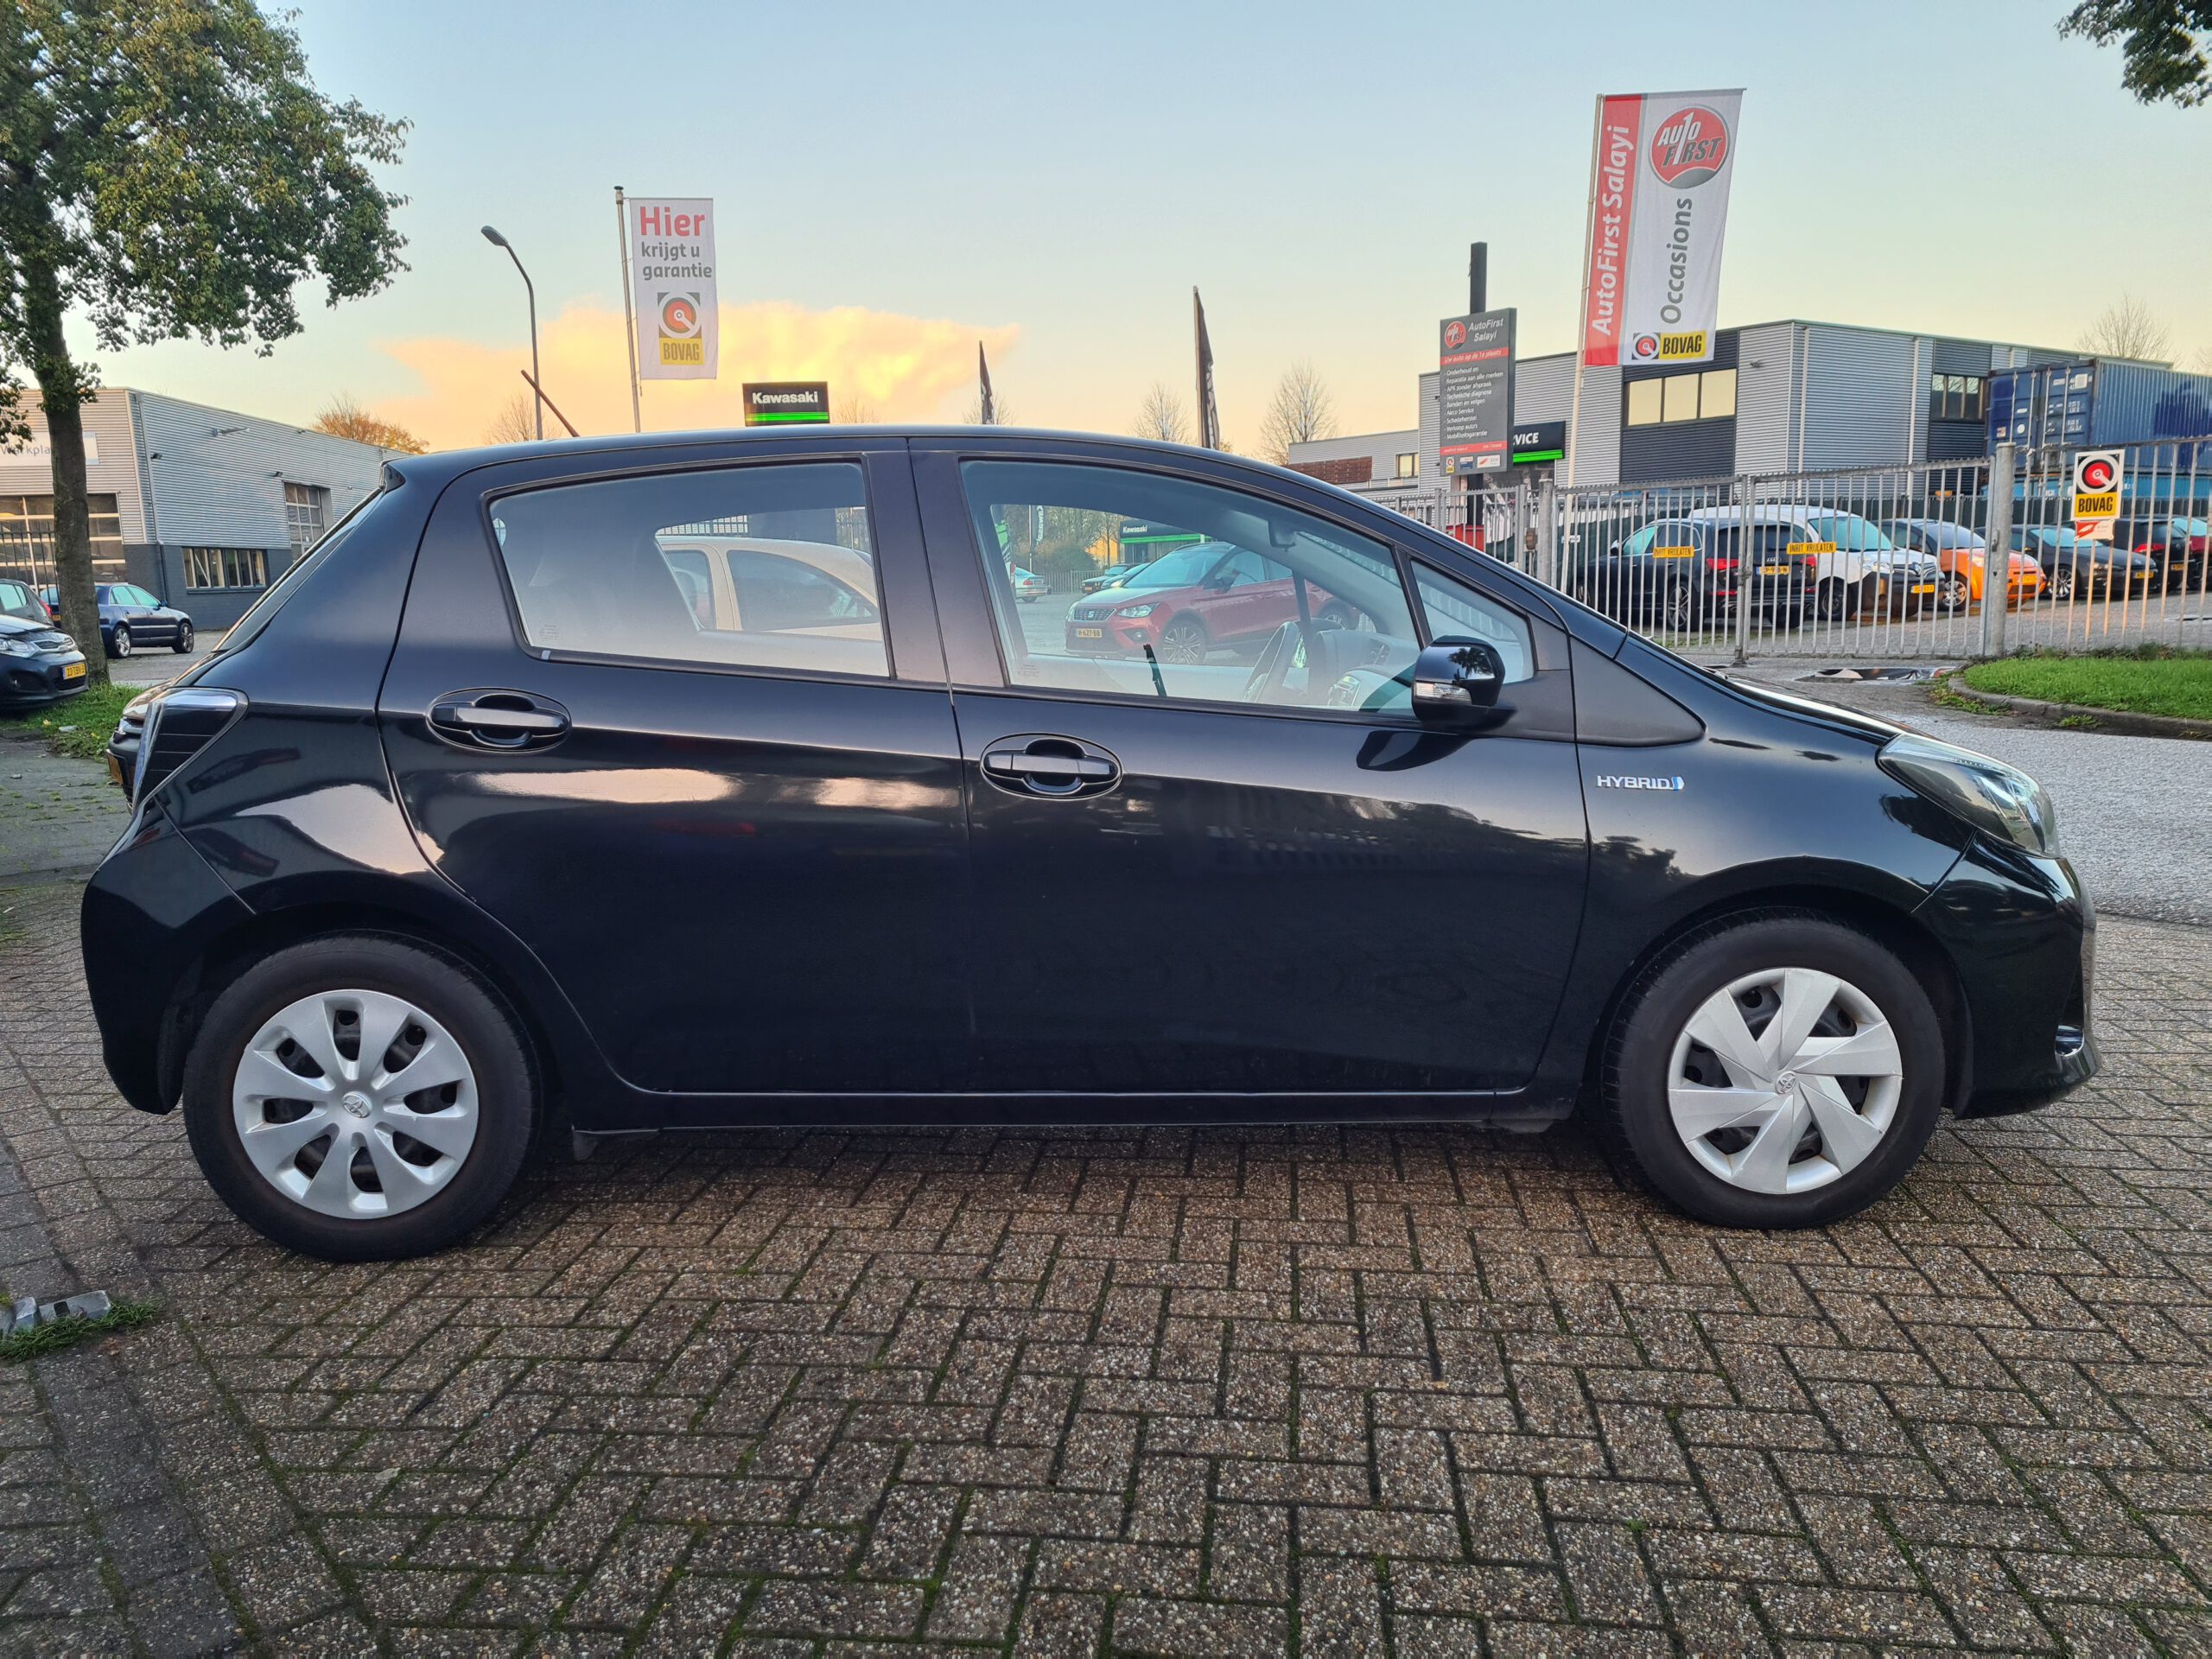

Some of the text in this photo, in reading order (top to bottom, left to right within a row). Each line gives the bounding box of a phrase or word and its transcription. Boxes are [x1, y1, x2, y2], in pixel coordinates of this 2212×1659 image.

[640, 206, 705, 237] Hier
[1592, 125, 1634, 335] AutoFirst Salayi
[641, 242, 700, 261] krijgt u
[1660, 197, 1693, 324] Occasions
[642, 263, 712, 281] garantie
[1468, 318, 1504, 332] AutoFirst
[1473, 330, 1497, 342] Salayi
[1662, 334, 1702, 354] BOVAG
[663, 342, 700, 361] BOVAG
[752, 391, 818, 404] Kawasaki
[2078, 496, 2113, 512] BOVAG
[1122, 524, 1147, 534] Kawasaki
[1597, 775, 1672, 790] HYBRID
